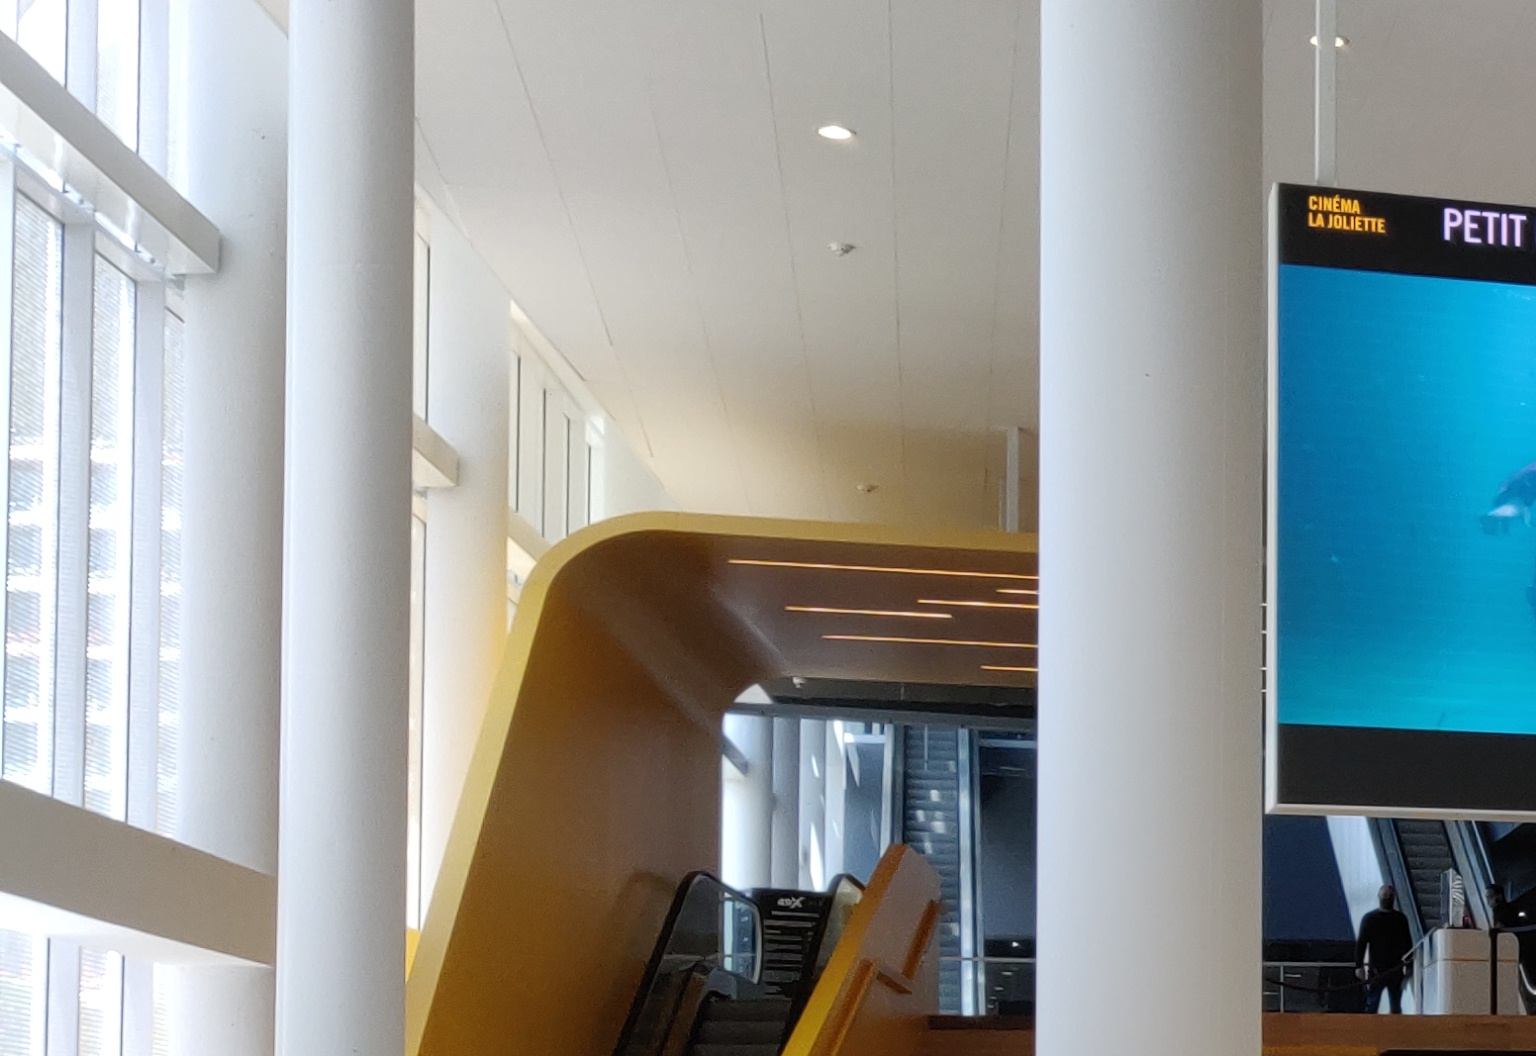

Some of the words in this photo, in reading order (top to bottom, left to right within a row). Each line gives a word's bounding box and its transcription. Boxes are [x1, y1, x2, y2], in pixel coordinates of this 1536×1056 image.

[1308, 194, 1361, 214] CINÉMA
[1307, 211, 1326, 229] LA
[1327, 214, 1387, 235] JOLIETTE
[1443, 206, 1527, 248] PETIT
